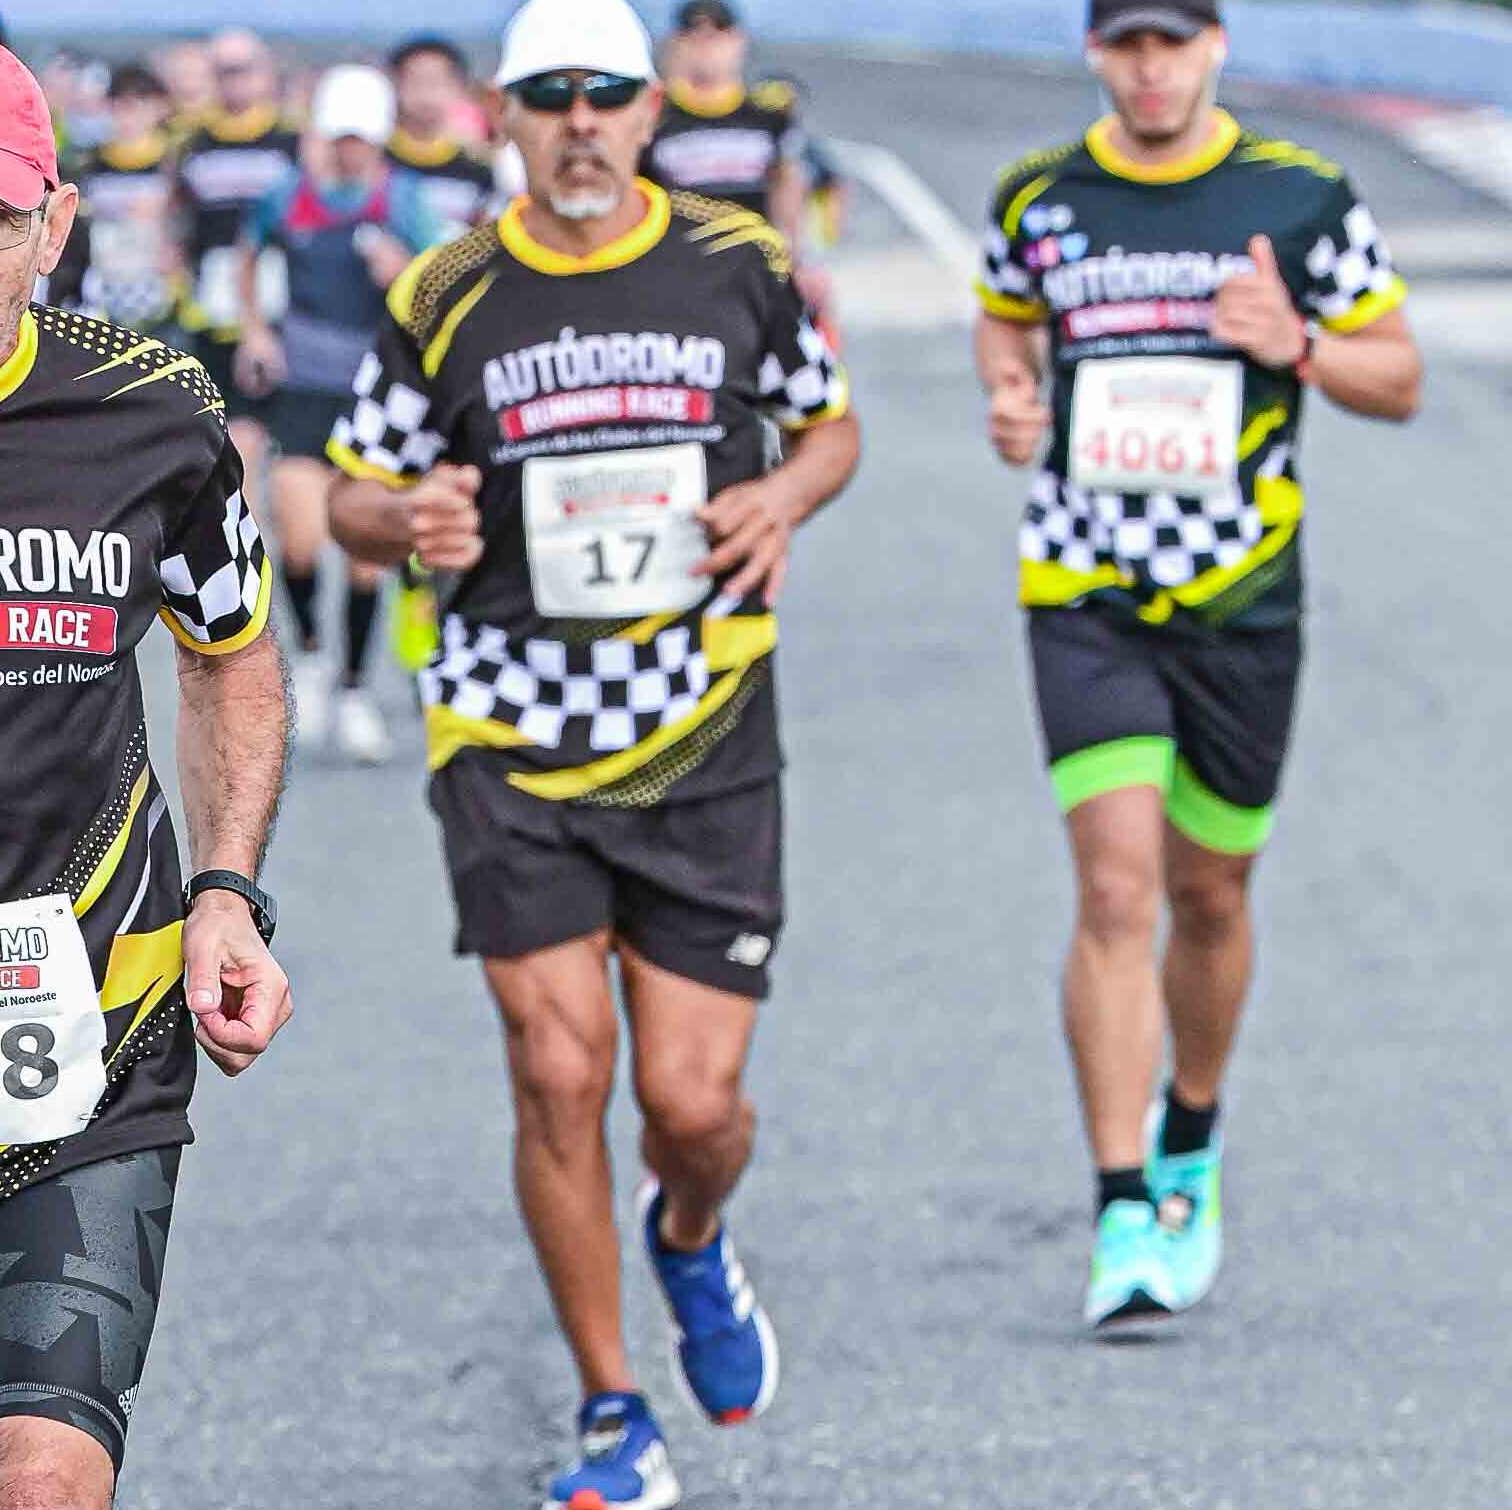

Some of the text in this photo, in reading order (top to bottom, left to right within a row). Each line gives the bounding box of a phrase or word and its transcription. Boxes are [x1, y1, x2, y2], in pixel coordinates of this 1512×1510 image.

[483, 326, 726, 411] AUTÓDROMO
[1083, 427, 1219, 476] 4061
[582, 534, 658, 588] 17
[7, 606, 91, 647] RACE
[32, 663, 64, 685] del
[10, 990, 57, 1007] Noroeste
